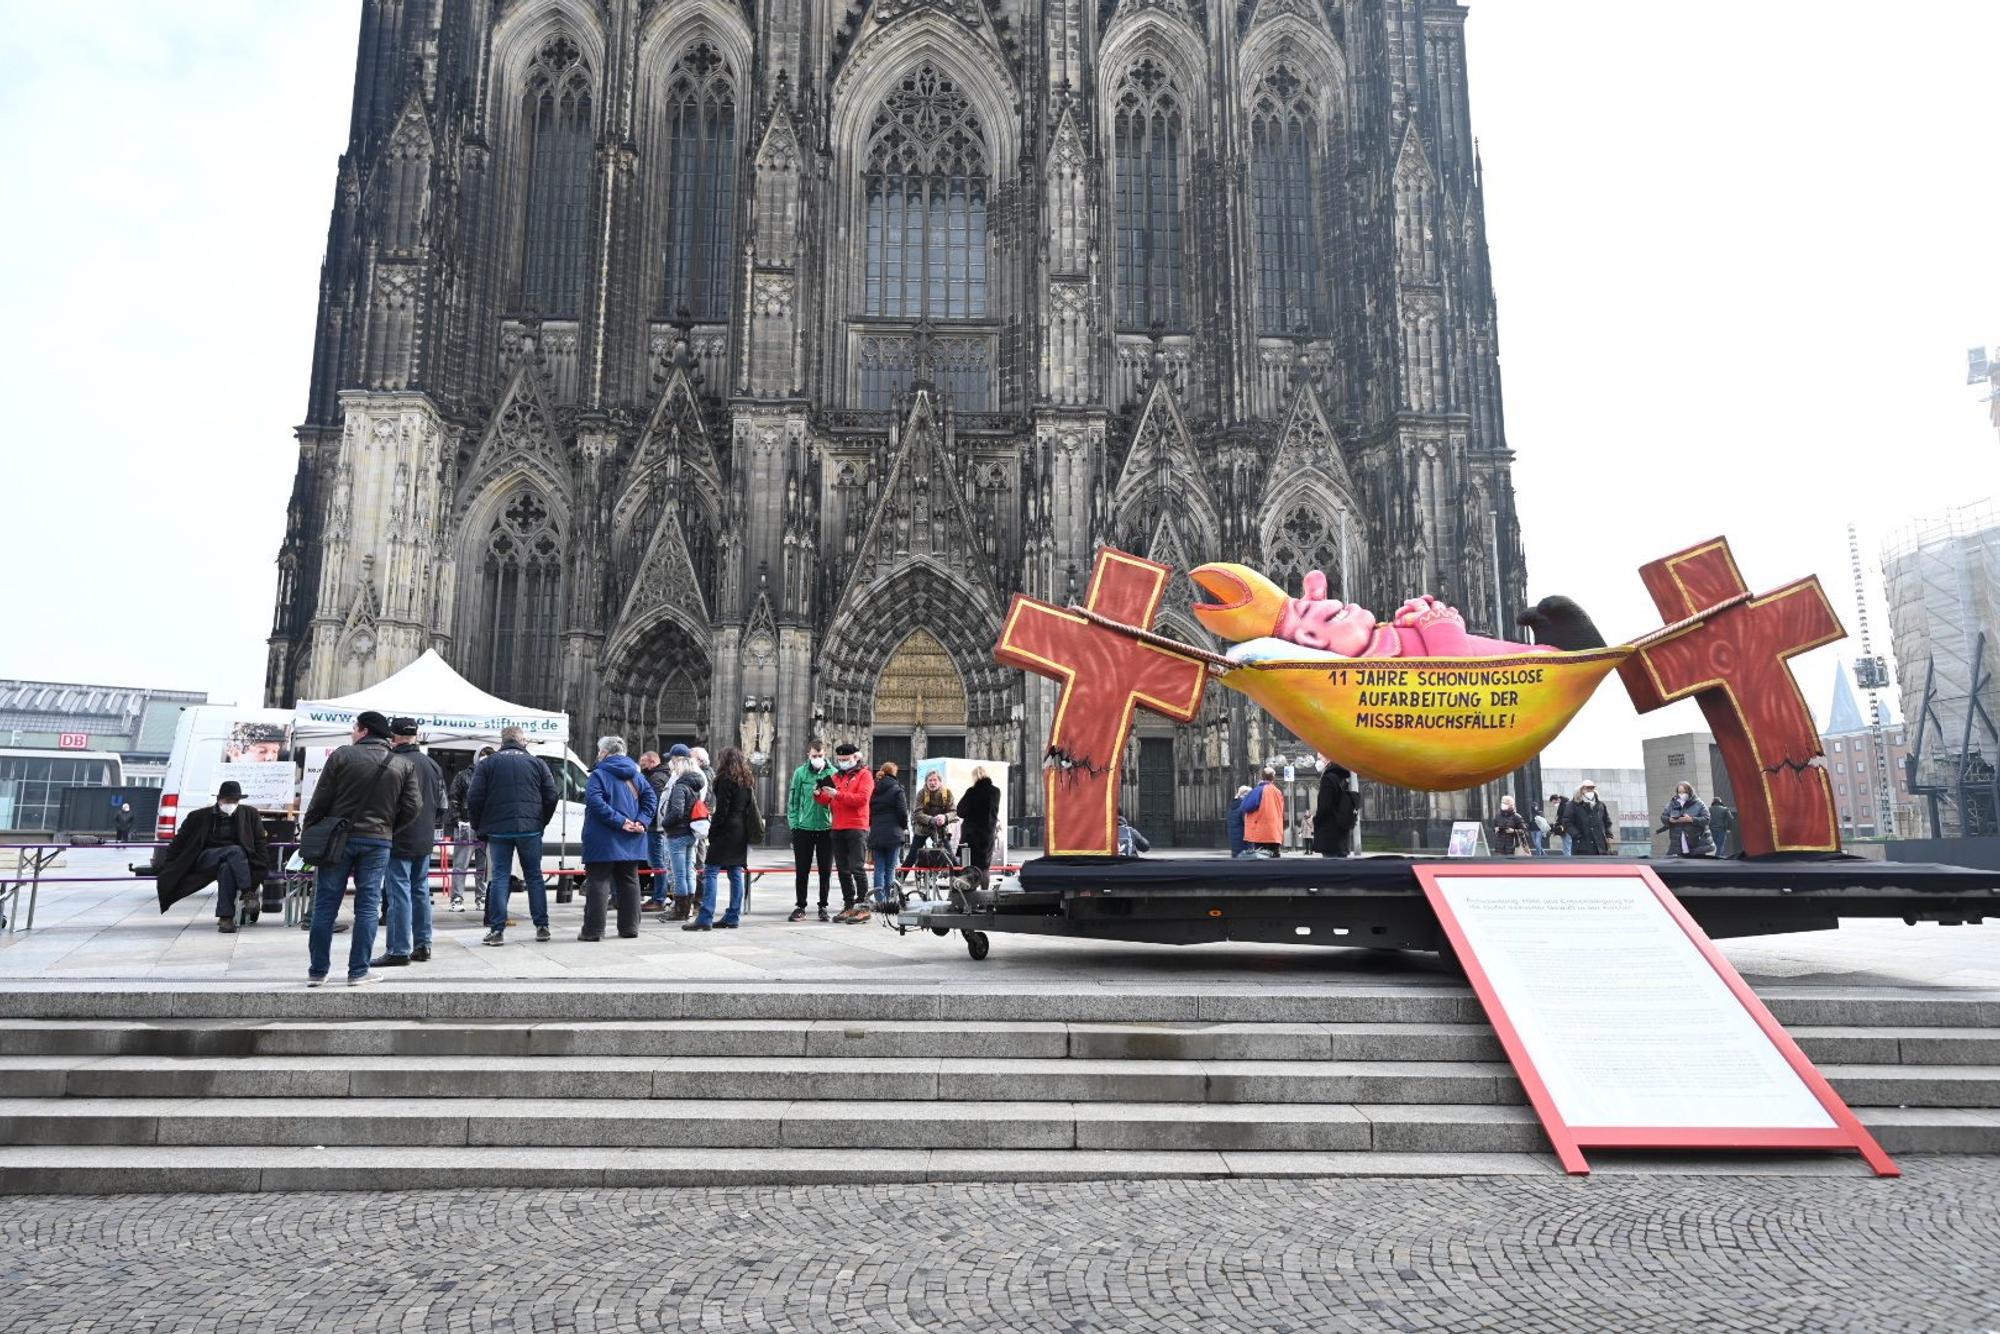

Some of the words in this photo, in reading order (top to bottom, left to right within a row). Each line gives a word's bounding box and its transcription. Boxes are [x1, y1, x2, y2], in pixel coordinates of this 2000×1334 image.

[1328, 670, 1347, 686] 11
[1355, 670, 1408, 686] JAHRE
[1418, 669, 1544, 687] SCHONUNGSLOSE
[1358, 690, 1482, 708] AUFARBEITUNG
[1490, 691, 1519, 707] DER
[61, 734, 86, 747] DB
